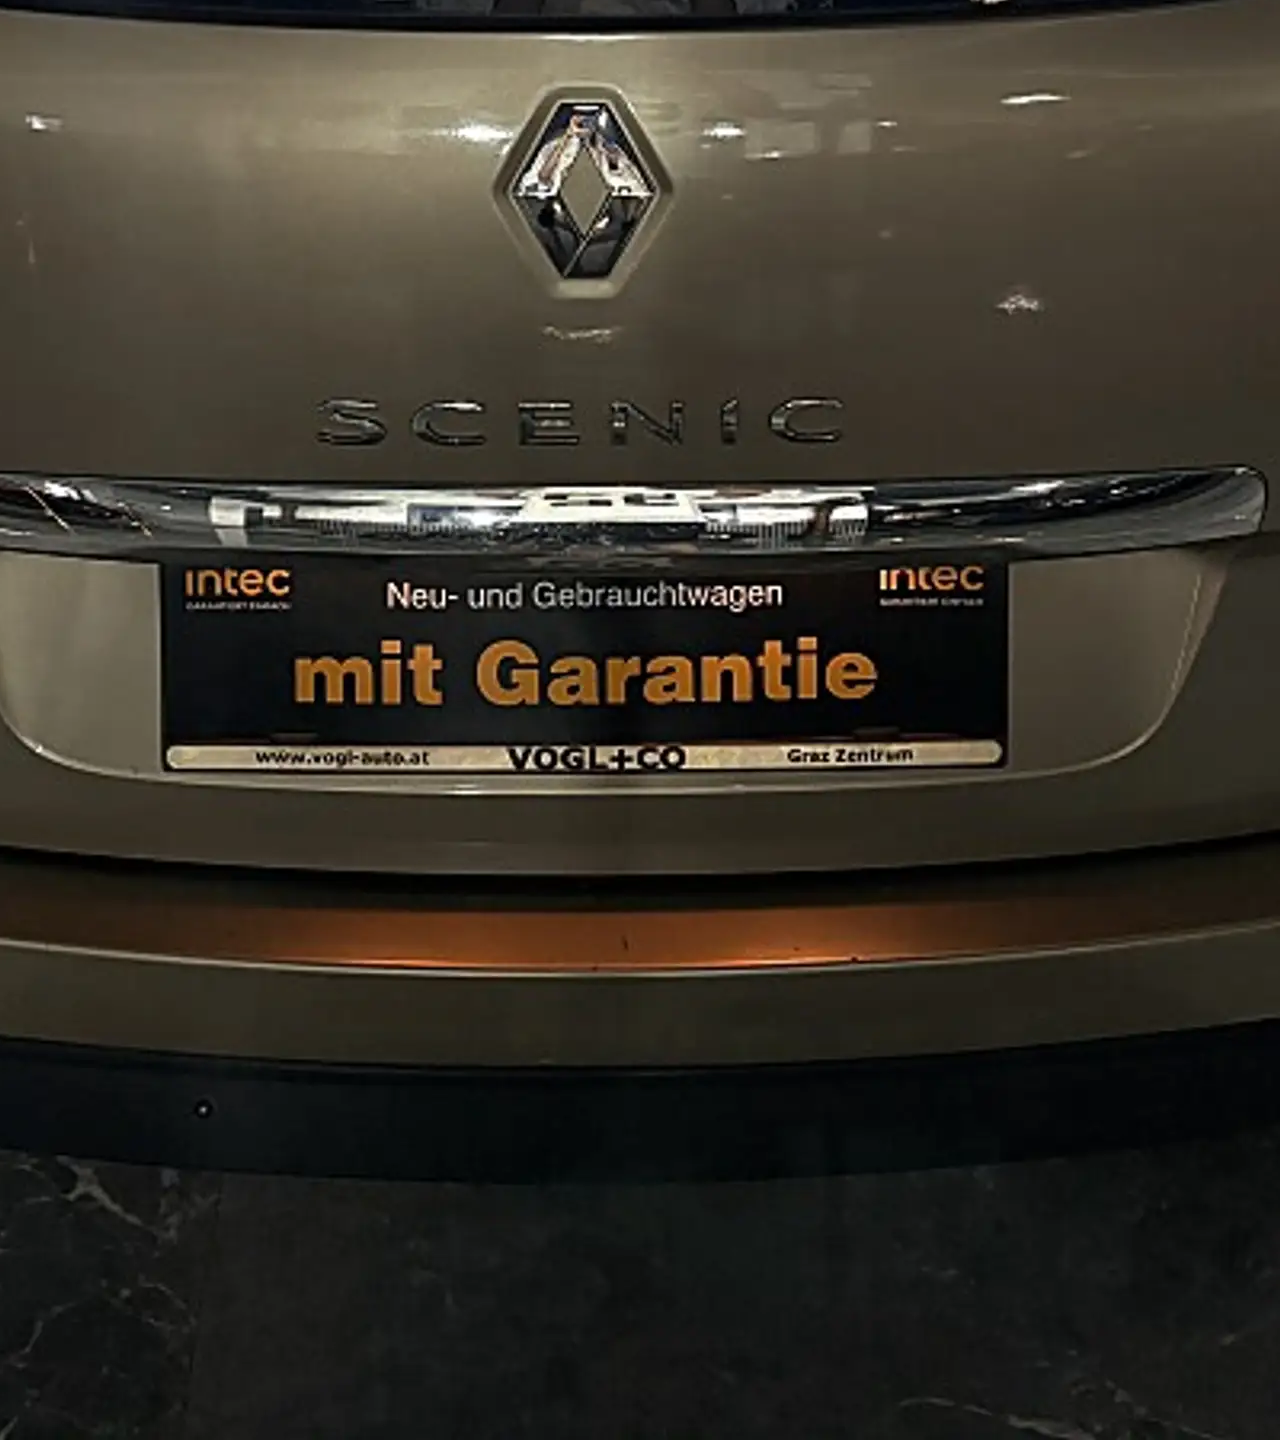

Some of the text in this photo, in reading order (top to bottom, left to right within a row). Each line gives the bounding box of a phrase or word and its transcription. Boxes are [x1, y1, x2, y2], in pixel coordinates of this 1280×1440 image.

[318, 398, 843, 447] SCENIC
[184, 566, 291, 597] intec
[879, 564, 985, 592] intec
[385, 580, 784, 613] Neu- und Gebrauchtwagen
[293, 636, 879, 706] mit Garantie
[508, 745, 686, 770] VOGL+CO
[786, 748, 914, 763] Graz Zentrum
